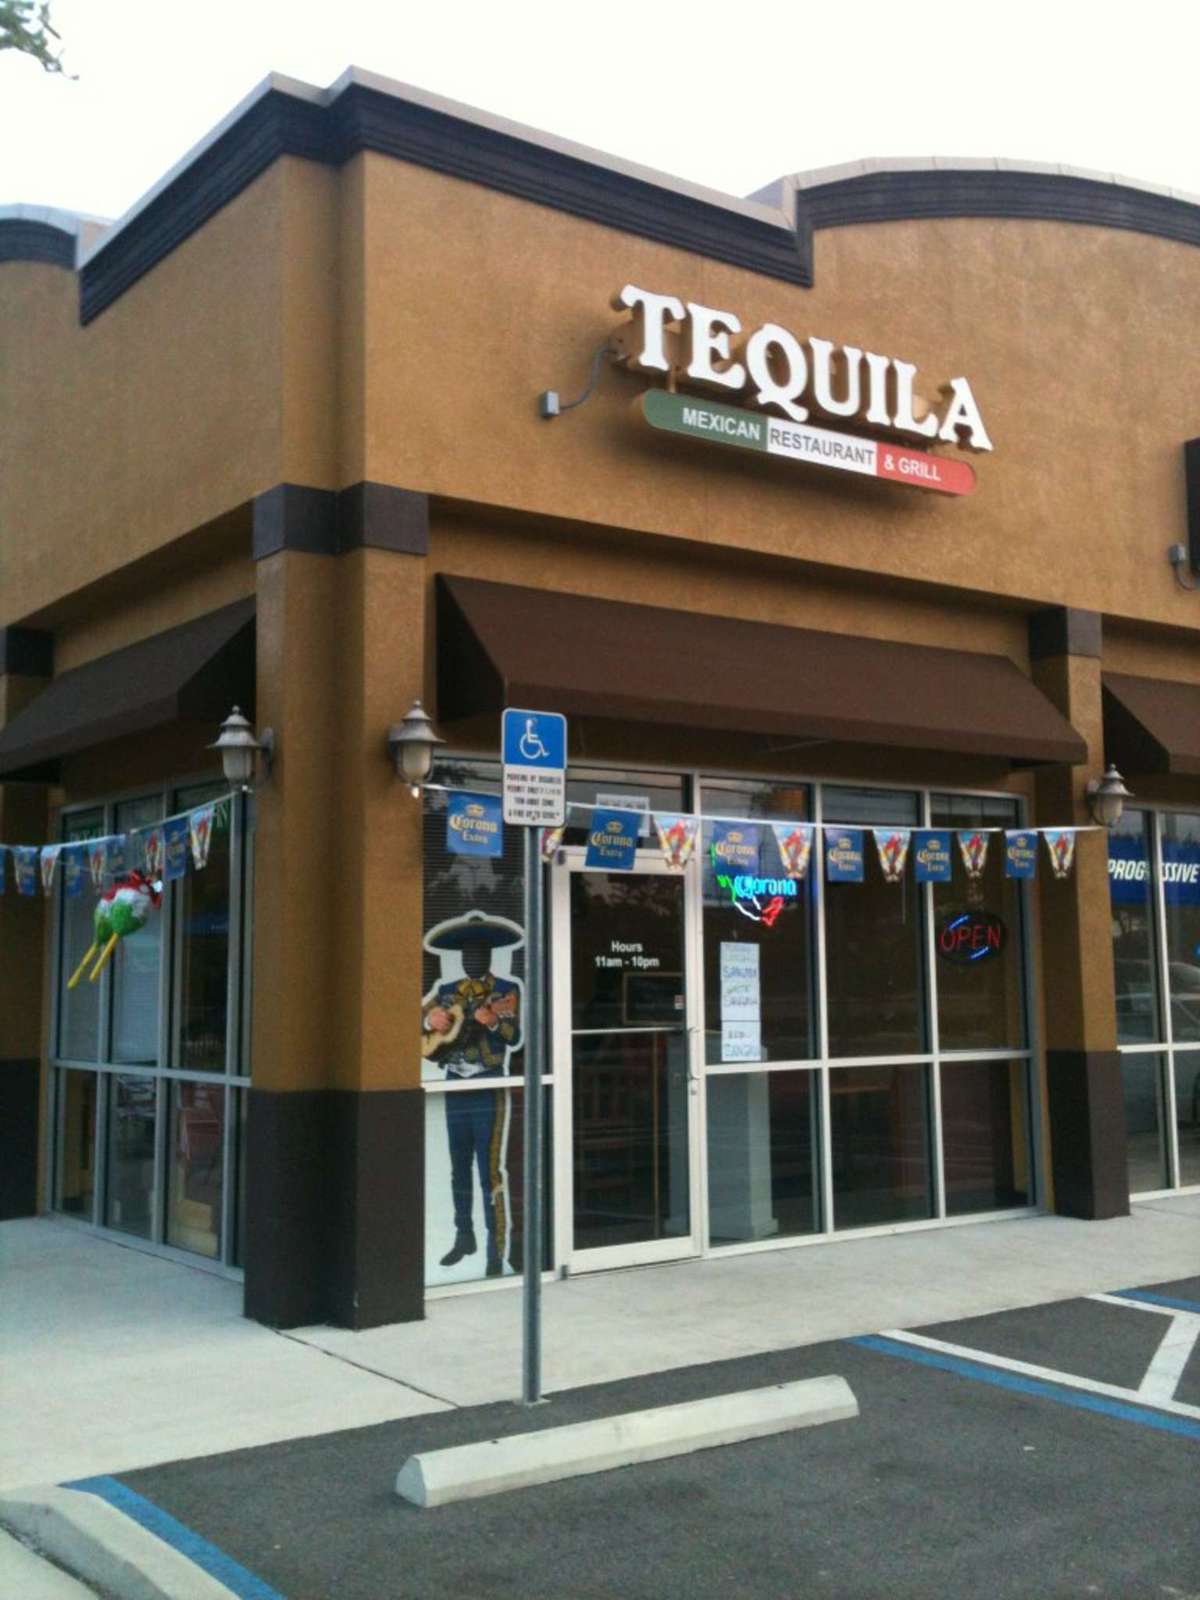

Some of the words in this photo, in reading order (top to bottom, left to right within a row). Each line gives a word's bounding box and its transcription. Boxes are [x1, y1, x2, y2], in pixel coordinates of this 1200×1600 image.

[621, 285, 993, 451] TEQUILA
[682, 407, 761, 441] MEXICAN
[769, 428, 875, 465] RESTAURANT
[884, 454, 895, 471] &
[899, 459, 941, 481] GRILL
[449, 814, 498, 833] Corona
[591, 831, 634, 847] Corona
[1107, 858, 1200, 883] PROGSSIVE
[735, 876, 798, 898] Corona
[611, 940, 643, 953] Hours
[939, 924, 1001, 951] OPEN
[595, 955, 623, 968] 11am
[632, 955, 660, 970] 10pm
